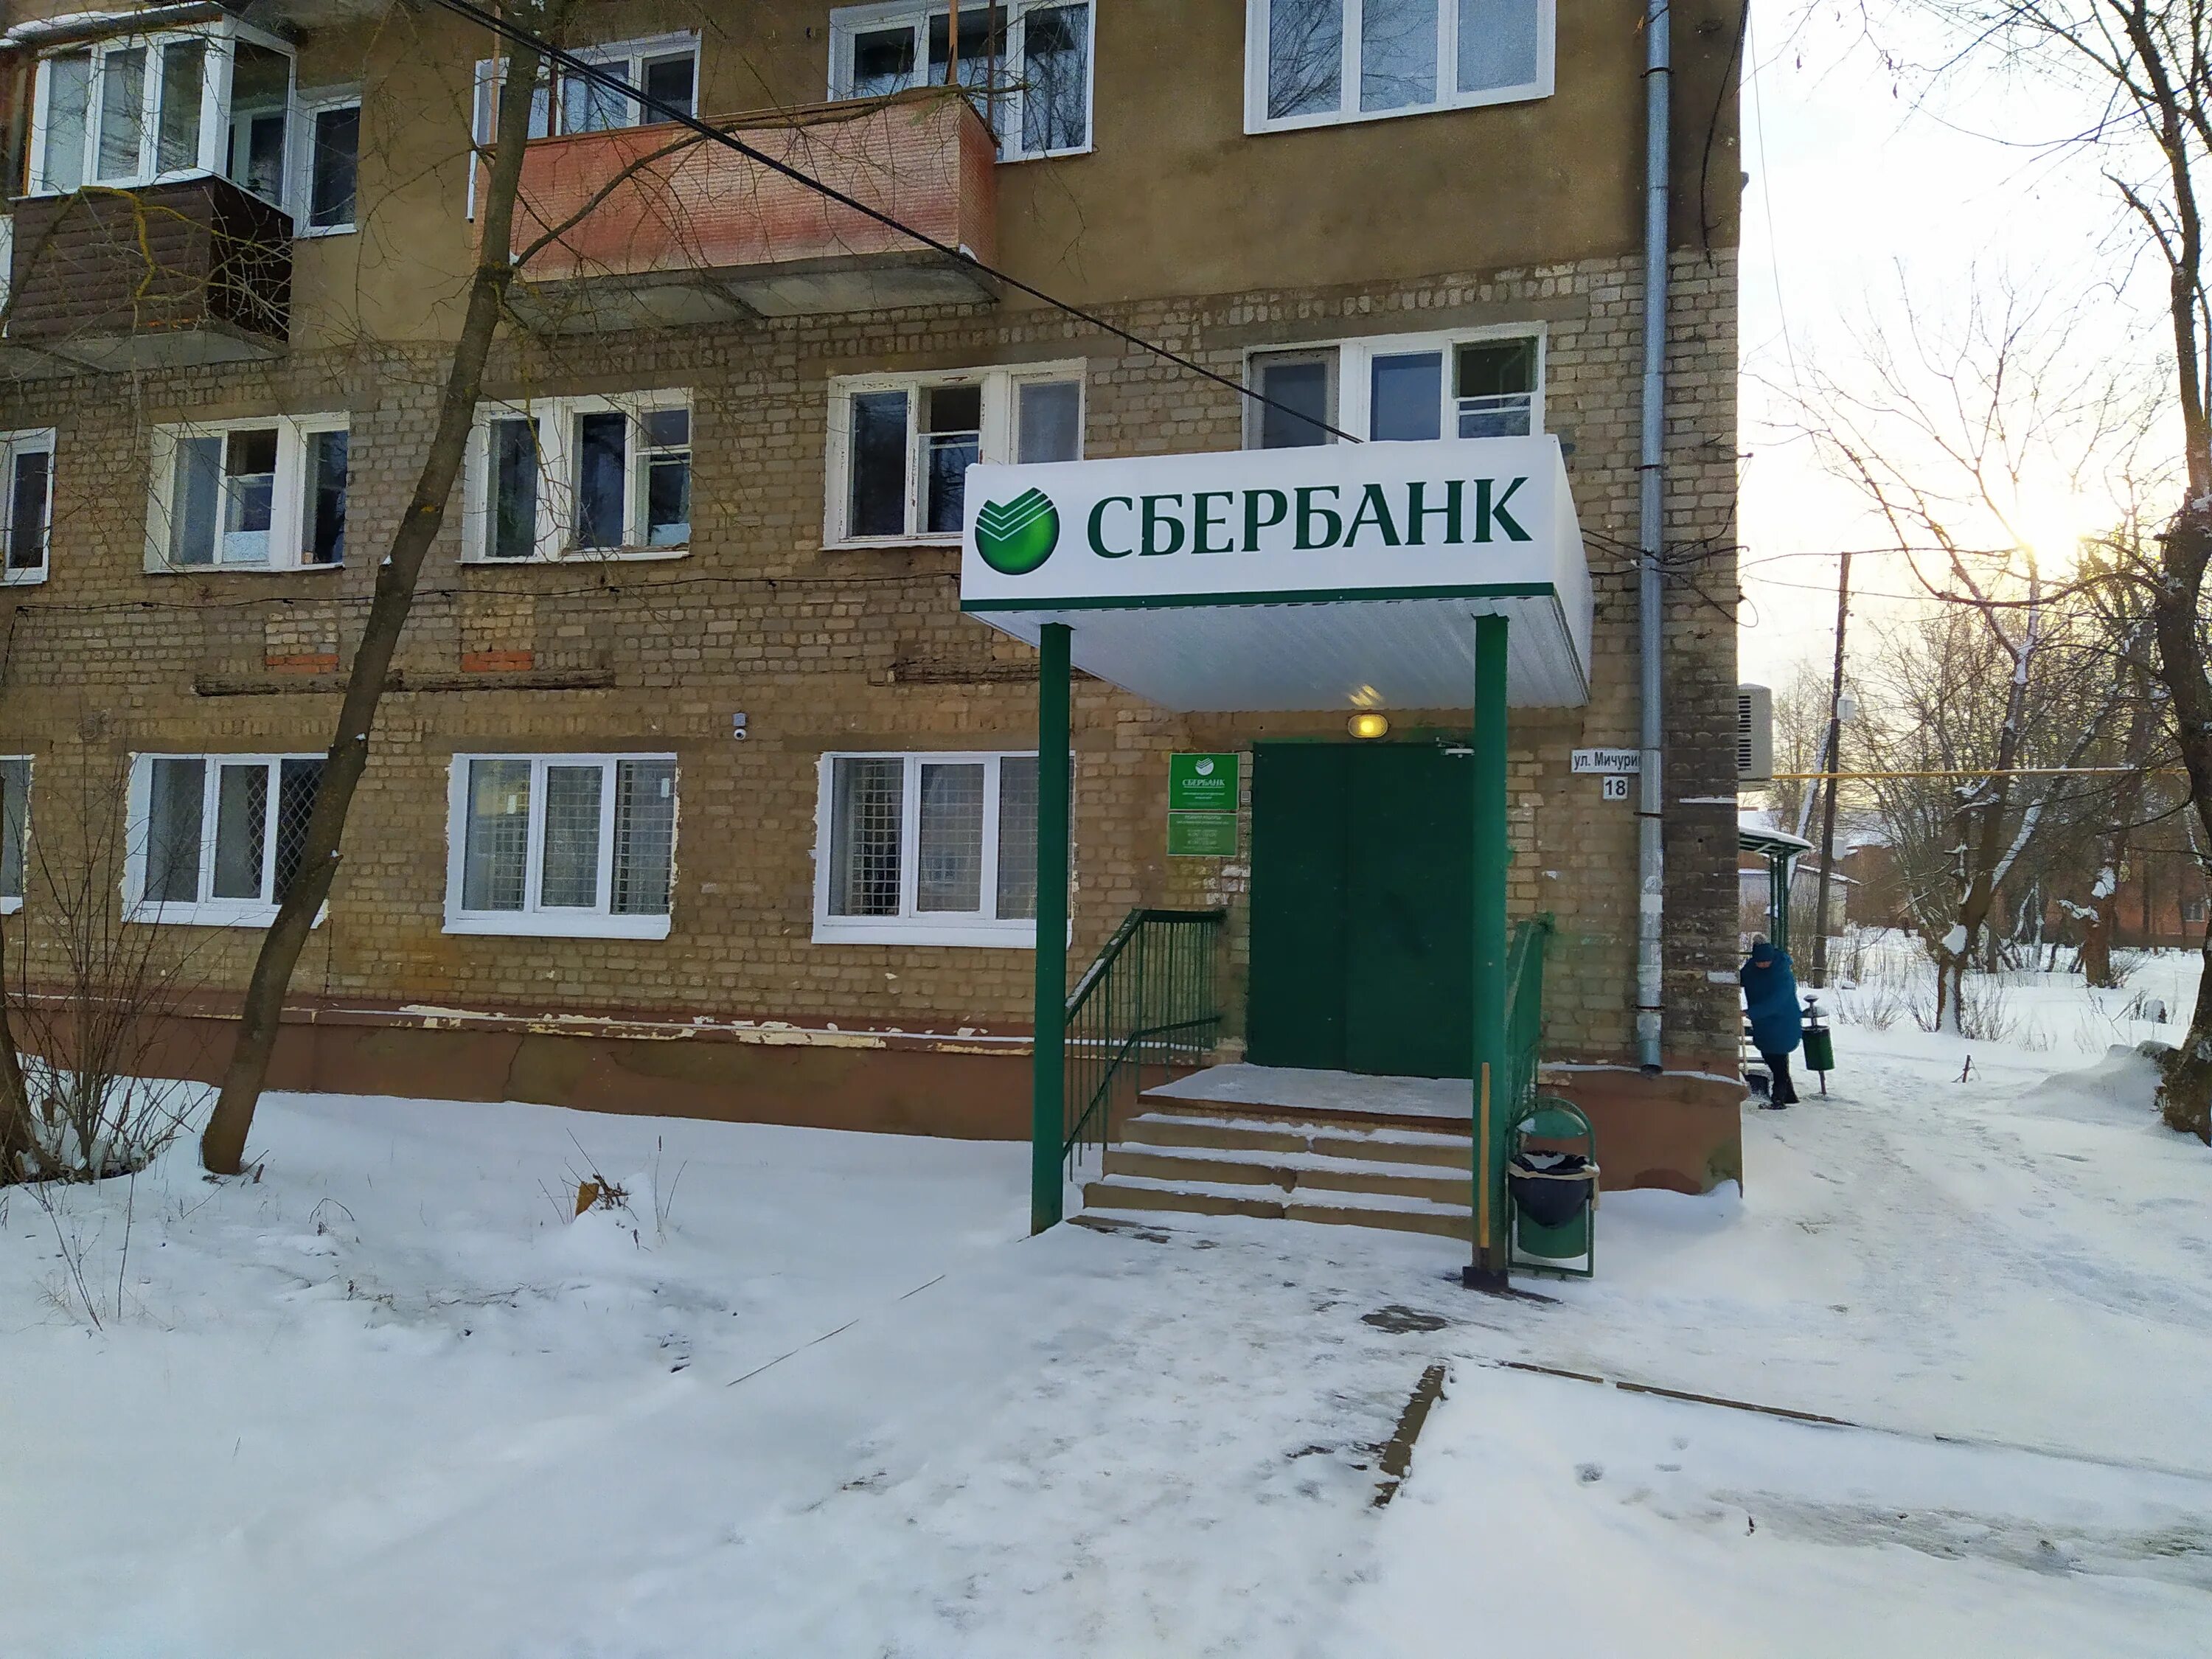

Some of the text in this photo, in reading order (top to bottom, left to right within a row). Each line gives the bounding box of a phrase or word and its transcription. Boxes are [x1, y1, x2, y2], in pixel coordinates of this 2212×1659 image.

[1086, 476, 1534, 559] СБЕРБАНК
[1574, 755, 1590, 770] ул.
[1605, 779, 1626, 796] 18
